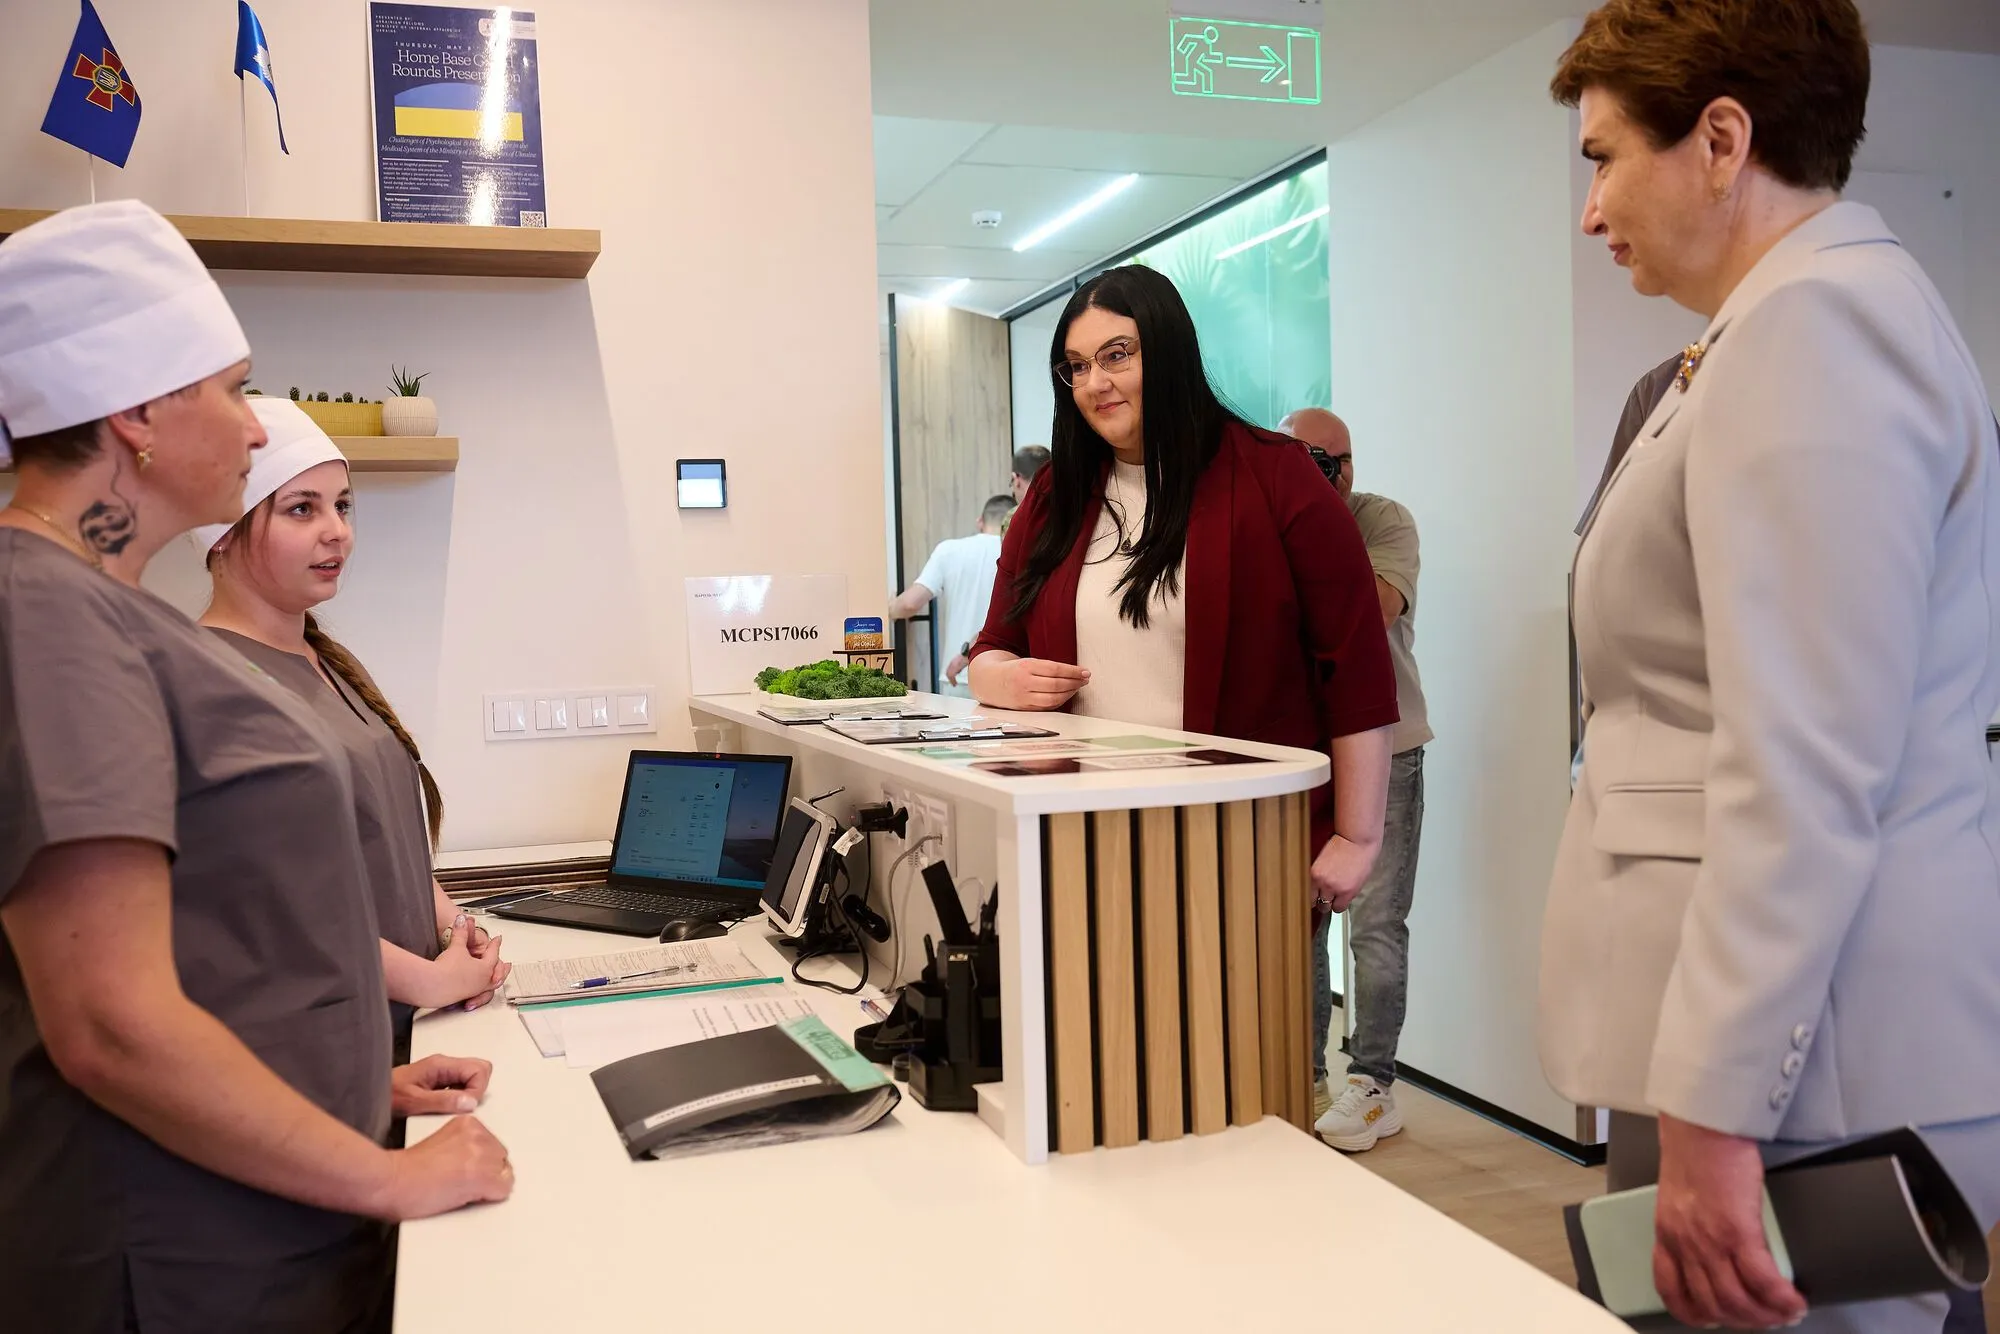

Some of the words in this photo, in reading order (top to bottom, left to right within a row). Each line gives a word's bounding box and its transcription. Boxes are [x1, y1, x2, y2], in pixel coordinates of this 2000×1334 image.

[397, 49, 440, 64] Home
[441, 52, 472, 66] Base
[391, 63, 442, 78] Rounds
[720, 625, 819, 643] MCPSI7066
